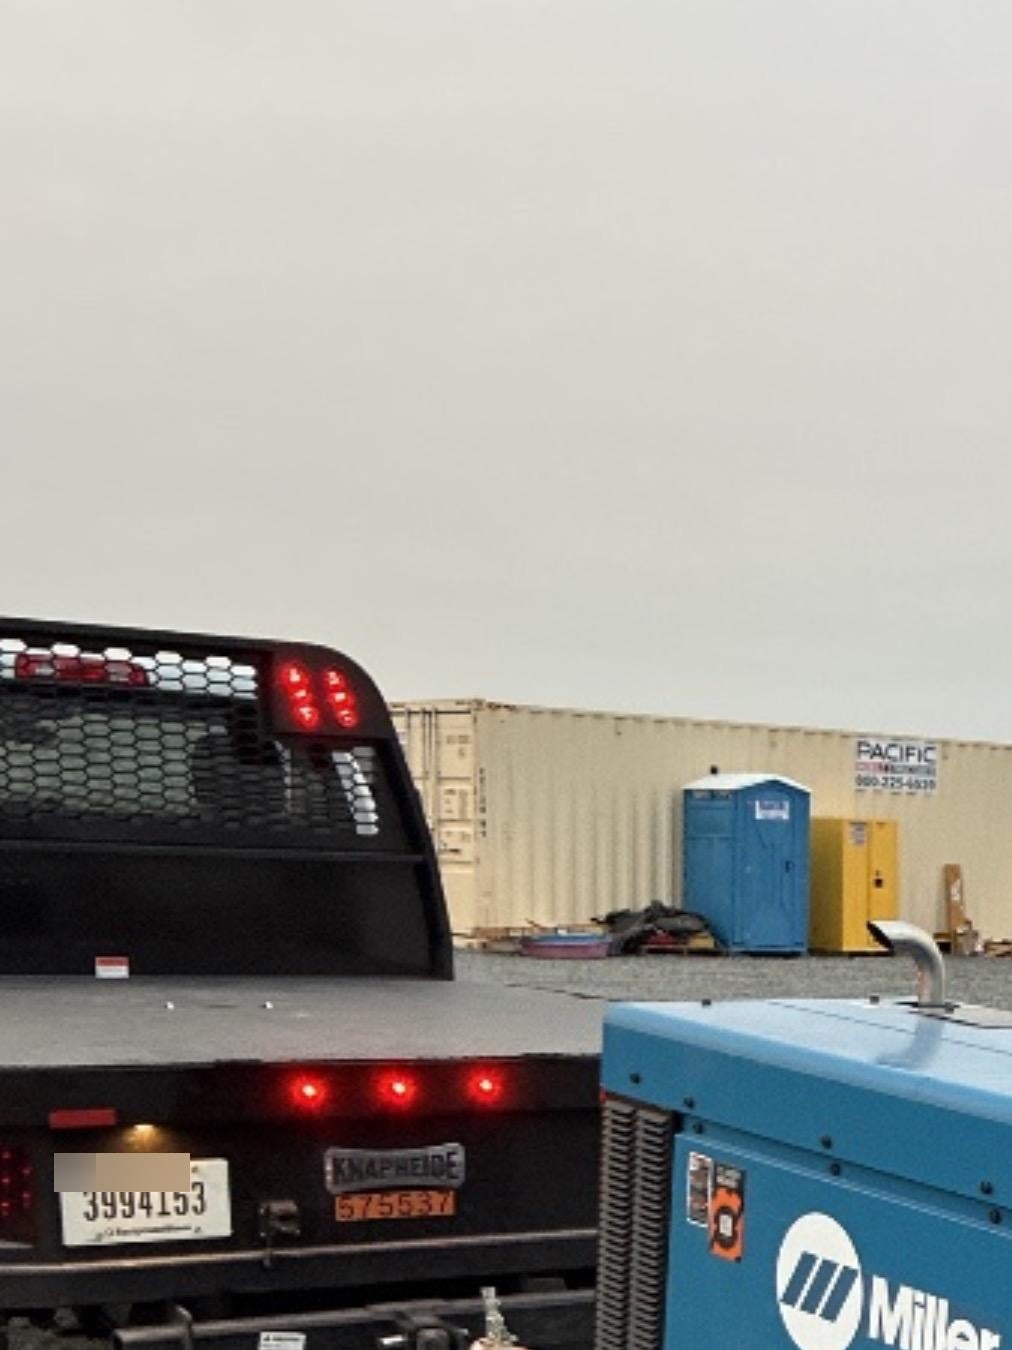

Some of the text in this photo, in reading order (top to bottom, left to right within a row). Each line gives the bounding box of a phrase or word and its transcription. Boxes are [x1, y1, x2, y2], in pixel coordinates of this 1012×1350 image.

[857, 740, 937, 763] PACIFIC
[332, 1150, 460, 1186] KNAPHEIDE
[338, 1192, 450, 1219] 575537
